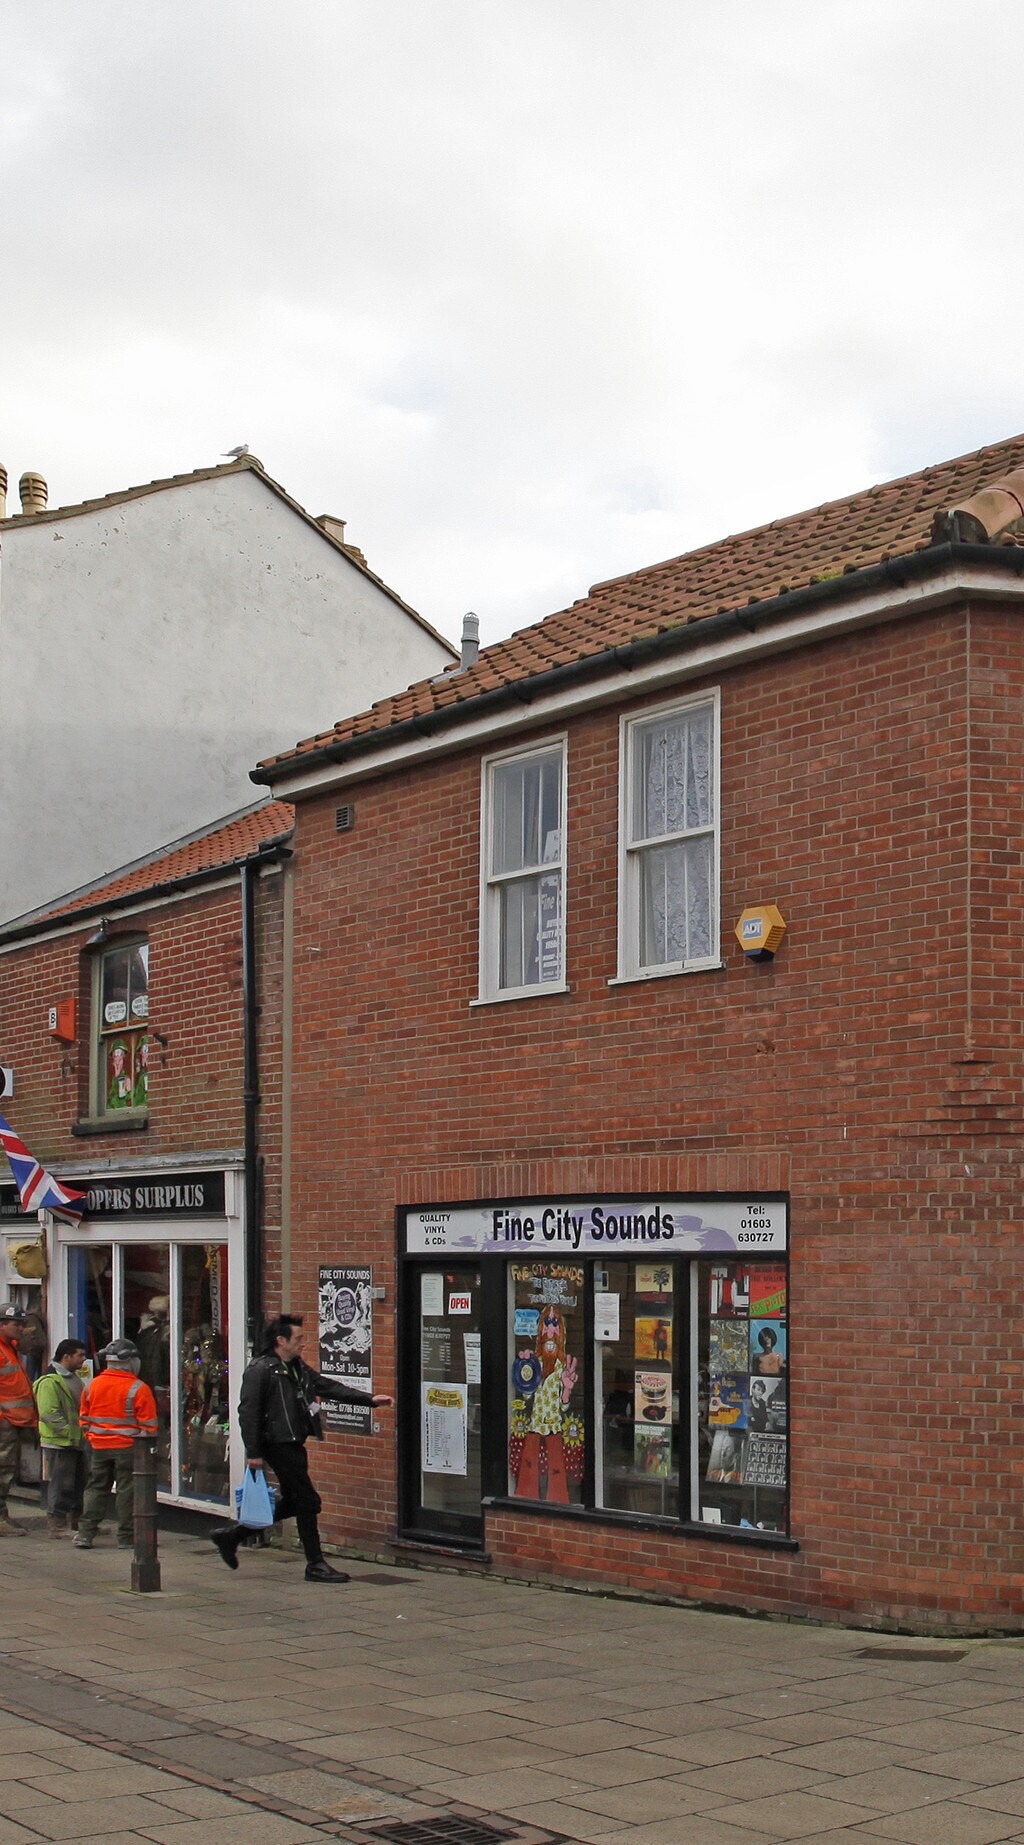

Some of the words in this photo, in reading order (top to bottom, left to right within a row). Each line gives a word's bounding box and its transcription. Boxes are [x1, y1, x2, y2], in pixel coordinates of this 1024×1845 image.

[743, 921, 763, 936] ADT
[135, 1184, 205, 1208] SURPLUS
[746, 1206, 765, 1215] Tel:
[419, 1214, 451, 1223] QUALITY
[493, 1210, 535, 1242] Fine
[542, 1208, 584, 1249] City
[590, 1206, 675, 1241] Sounds
[740, 1219, 772, 1229] 01603
[424, 1226, 447, 1234] VINYL
[738, 1233, 774, 1242] 630727
[320, 1270, 333, 1279] FINE
[333, 1270, 347, 1279] CITY
[347, 1270, 371, 1280] SOUNDS
[531, 1263, 548, 1276] CITY
[550, 1263, 584, 1287] SOUNDS
[450, 1297, 469, 1309] OPEN
[321, 1361, 345, 1373] Mon-Sat
[347, 1363, 369, 1375] 10-5pm
[321, 1402, 338, 1411] Mobile:
